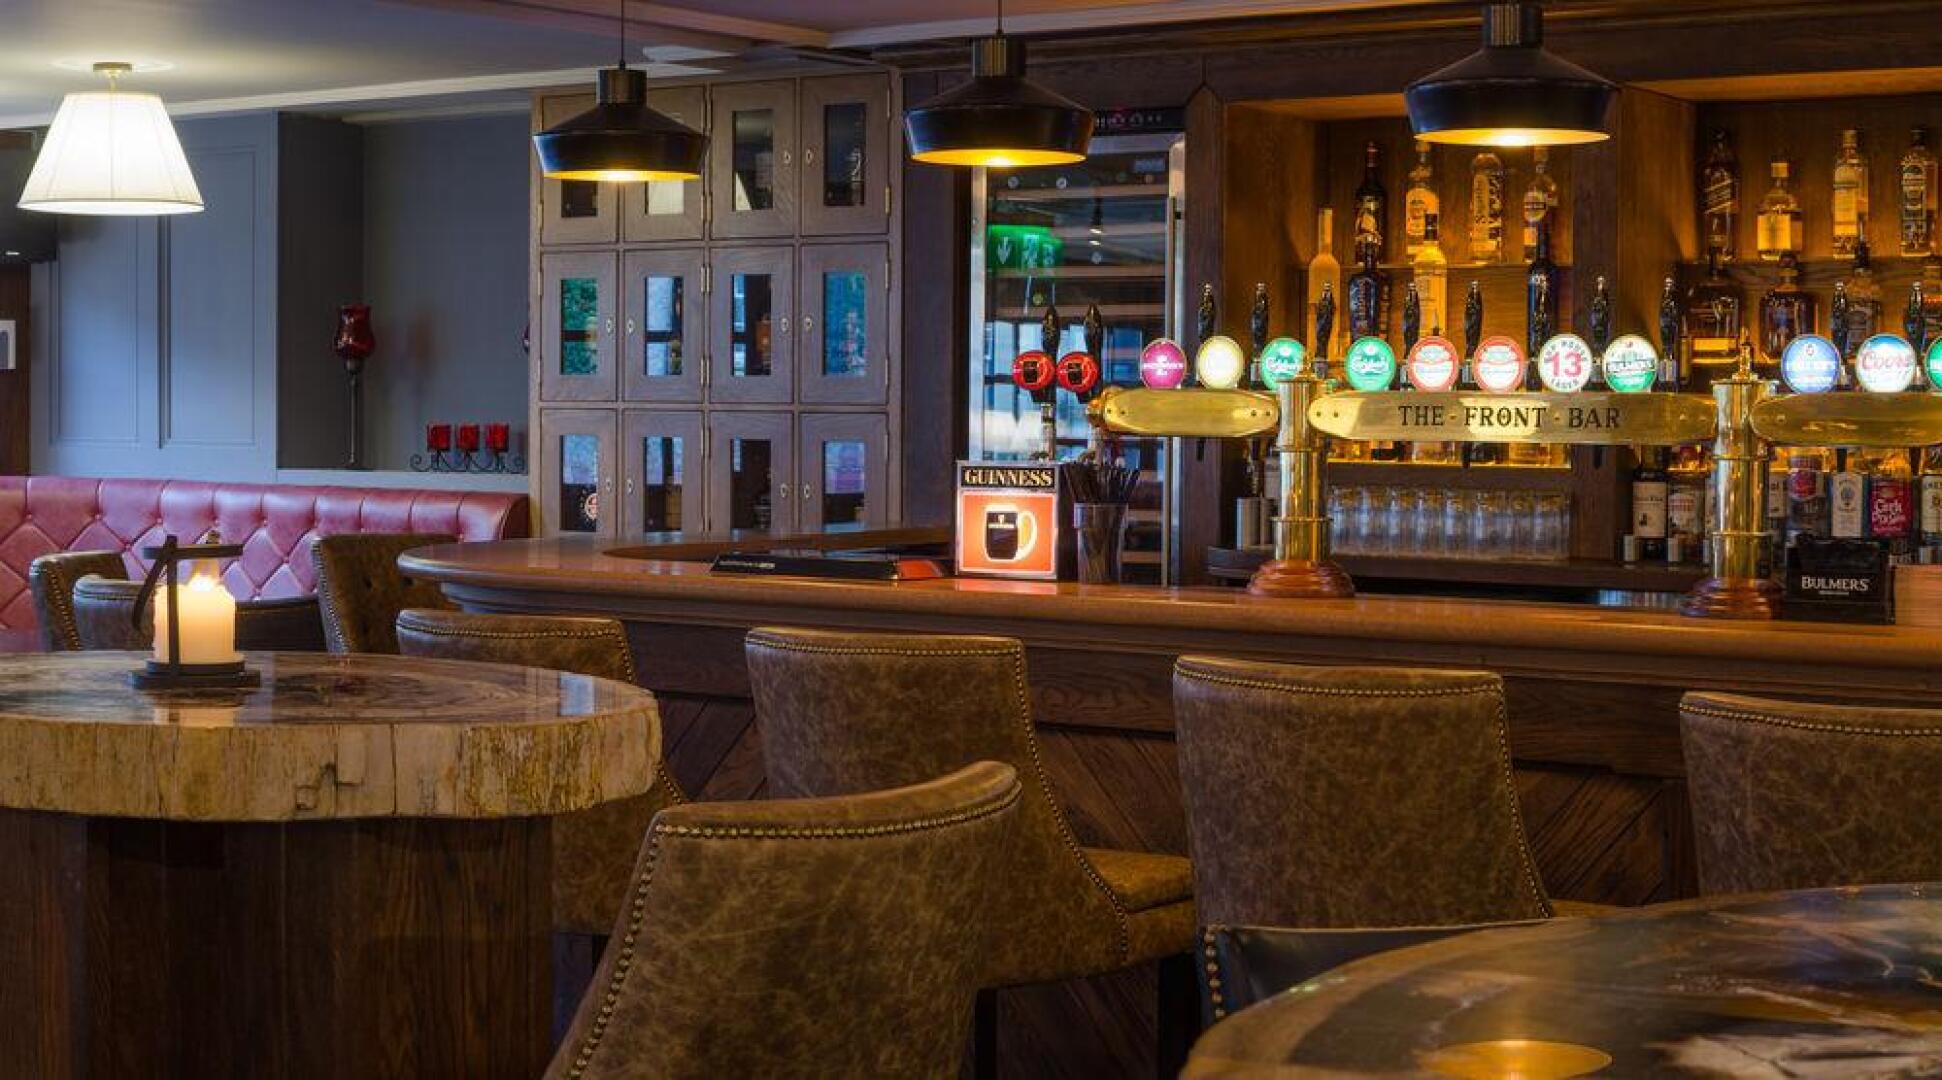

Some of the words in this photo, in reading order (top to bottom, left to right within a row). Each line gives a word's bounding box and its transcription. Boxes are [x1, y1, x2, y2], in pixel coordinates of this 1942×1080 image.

[1551, 351, 1582, 378] 13
[1398, 406, 1444, 426] THE
[1463, 407, 1547, 428] FRONT
[1568, 407, 1621, 429] BAR
[963, 468, 1053, 487] GUINNESS
[1801, 574, 1870, 592] BULMERS
